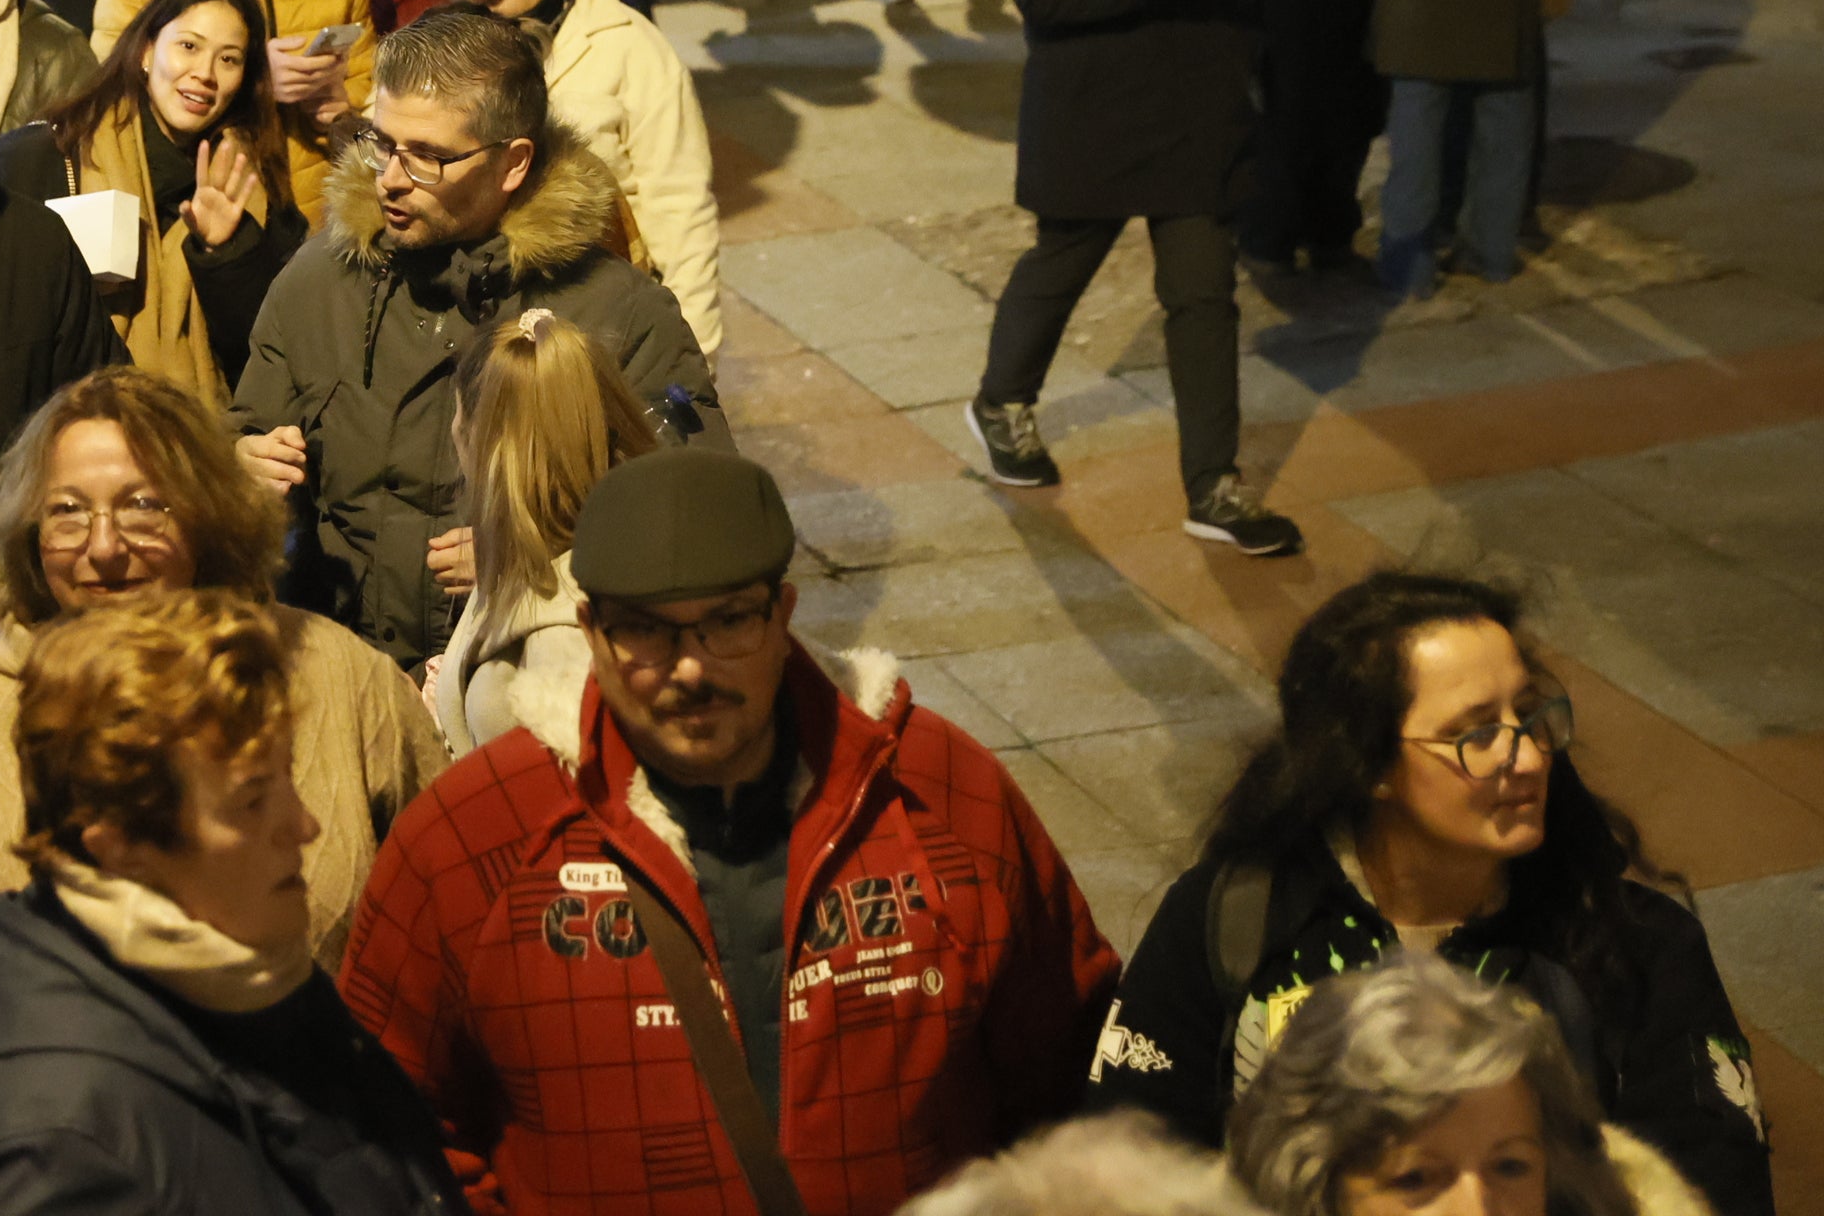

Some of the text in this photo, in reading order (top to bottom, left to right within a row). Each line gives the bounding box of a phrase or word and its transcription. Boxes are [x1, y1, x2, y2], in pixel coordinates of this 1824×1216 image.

[565, 869, 623, 887] King Ti
[635, 1004, 681, 1027] STY
